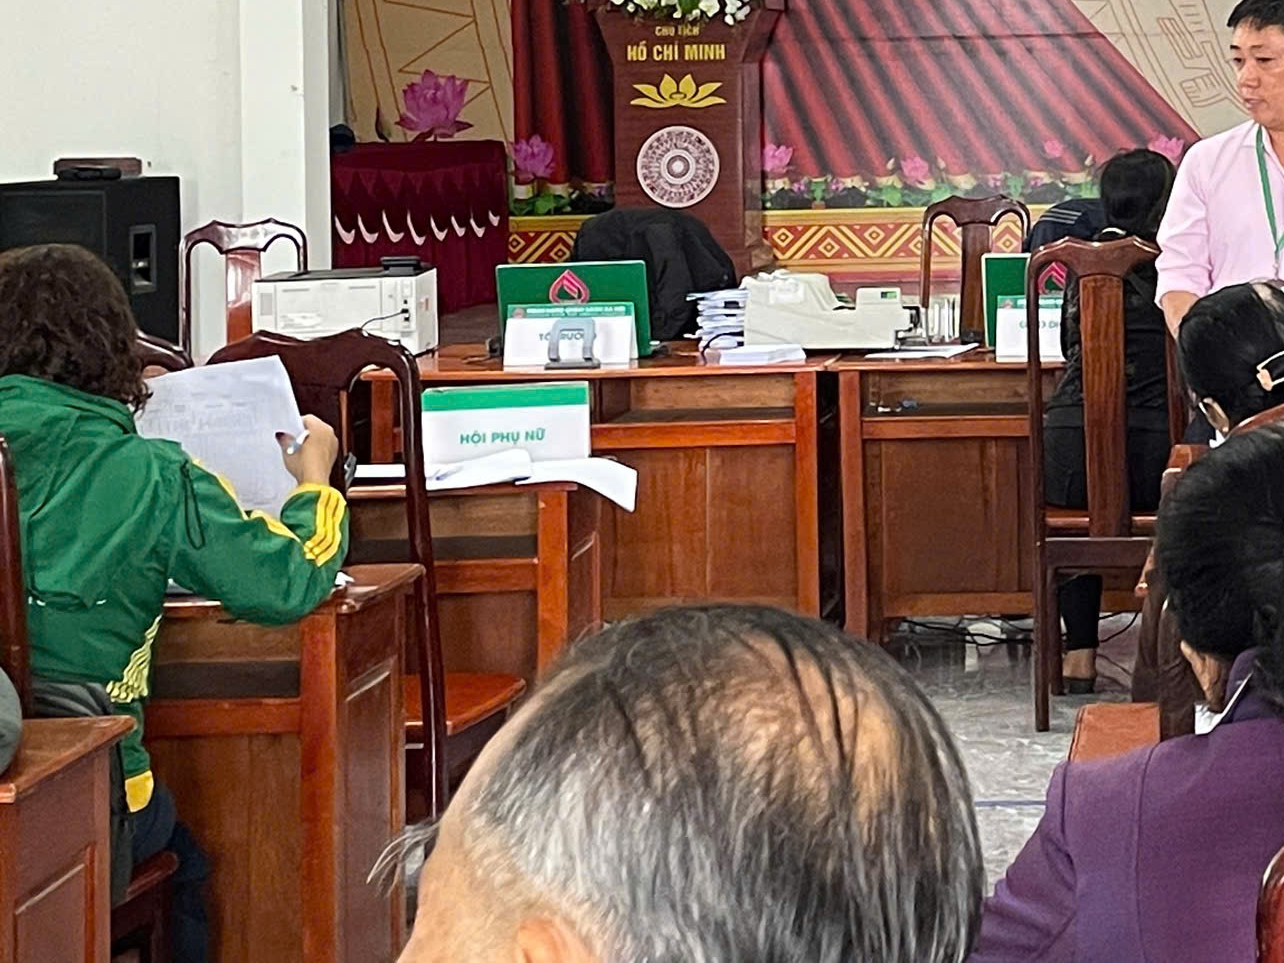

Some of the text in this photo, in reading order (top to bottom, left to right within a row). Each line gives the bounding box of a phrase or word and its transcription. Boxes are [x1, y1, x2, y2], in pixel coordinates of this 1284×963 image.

[653, 40, 679, 61] CHÍ
[684, 44, 726, 61] MINH
[491, 431, 520, 445] PHỤ
